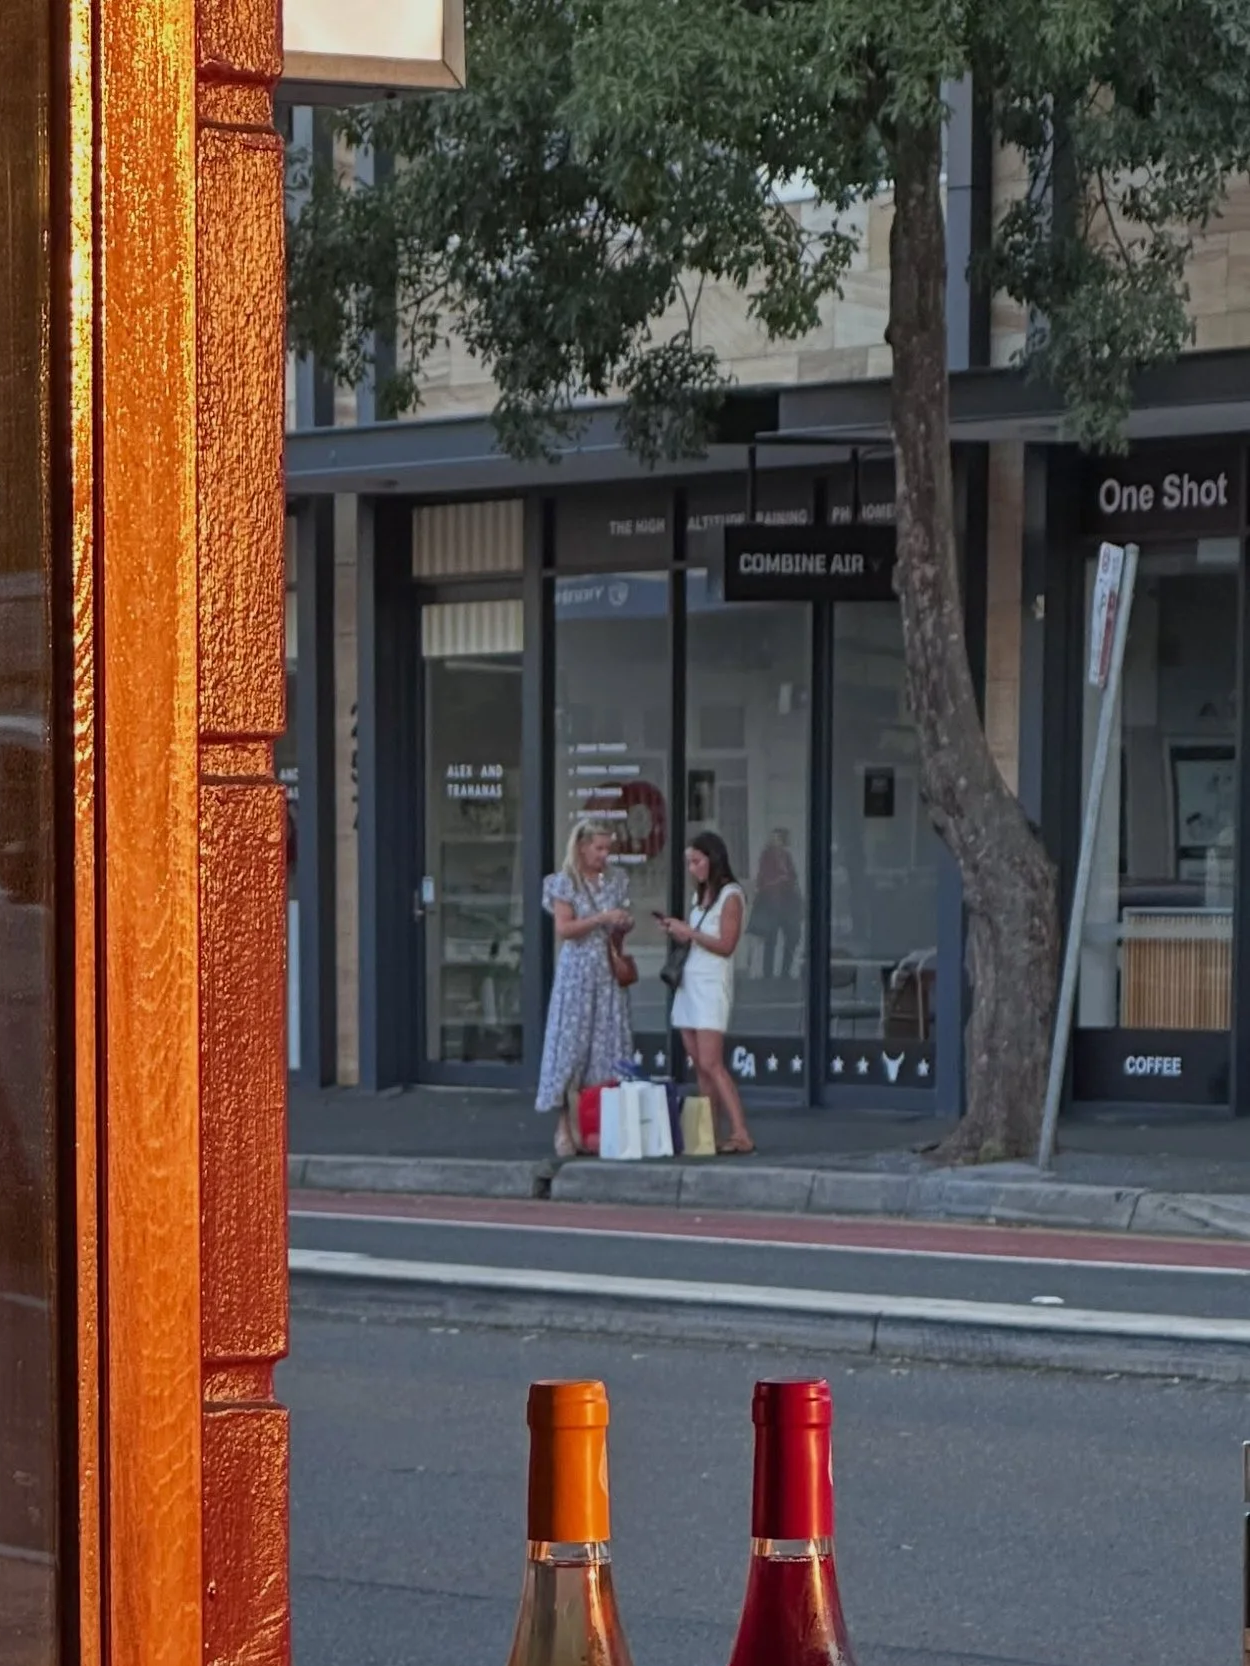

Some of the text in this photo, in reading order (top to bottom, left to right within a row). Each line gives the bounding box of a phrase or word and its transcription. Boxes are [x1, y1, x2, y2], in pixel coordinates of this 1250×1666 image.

[1101, 472, 1228, 514] One Shot
[609, 519, 633, 536] THE
[635, 517, 666, 534] HIGH
[739, 553, 864, 575] COMBINE AIR
[447, 763, 503, 778] ALEX AND
[1125, 1055, 1181, 1075] COFFEE
